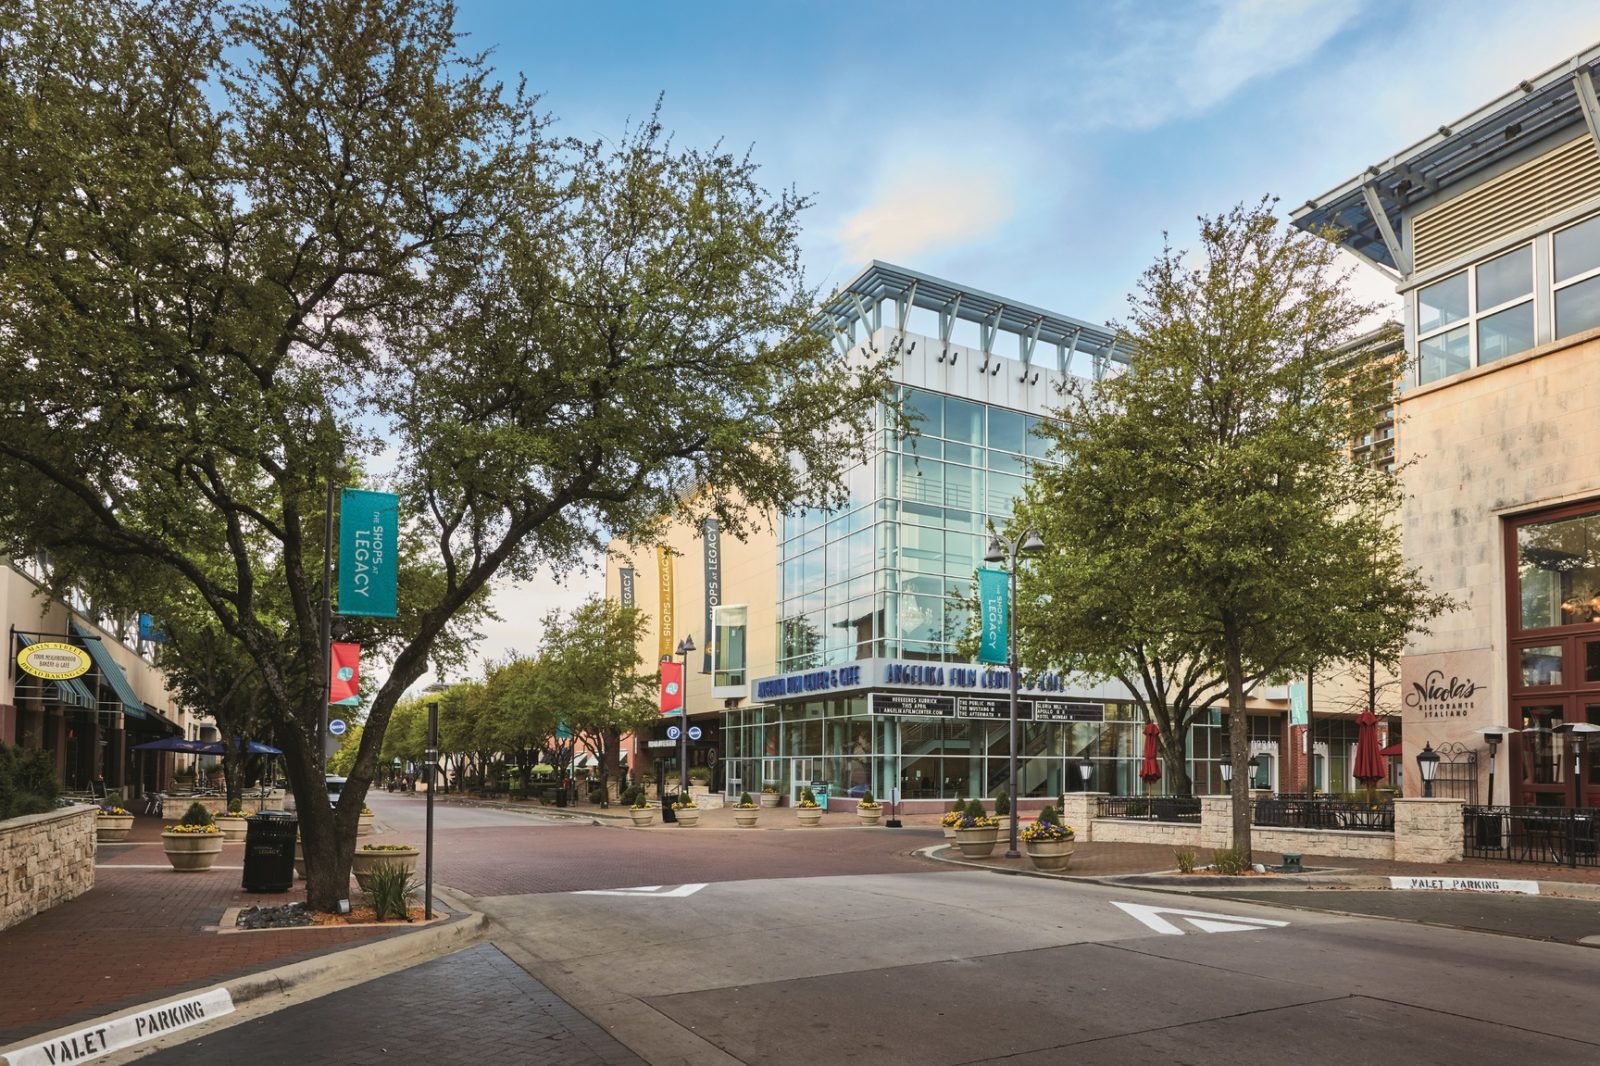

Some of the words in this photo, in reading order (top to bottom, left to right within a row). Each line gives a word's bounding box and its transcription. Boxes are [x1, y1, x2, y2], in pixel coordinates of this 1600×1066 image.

[372, 526, 383, 564] SHOPS
[708, 526, 717, 570] LEGACY
[354, 530, 370, 597] LEGACY
[372, 566, 378, 575] AT
[712, 571, 717, 581] AT
[663, 602, 671, 637] SHOPS
[988, 600, 997, 649] LEGACY
[28, 643, 49, 652] MAIN
[54, 643, 82, 656] STREET
[21, 662, 43, 678] BREAD
[885, 663, 944, 685] ANGELIKA
[950, 667, 977, 688] FILM
[1405, 670, 1487, 707] Nicola's
[1418, 702, 1474, 711] RISTORANTE
[1424, 710, 1467, 718] ITALIANO
[1410, 878, 1444, 889] VALET
[1453, 879, 1499, 890] PARKING
[43, 1028, 107, 1066] VALET
[135, 1000, 205, 1037] PARKING
